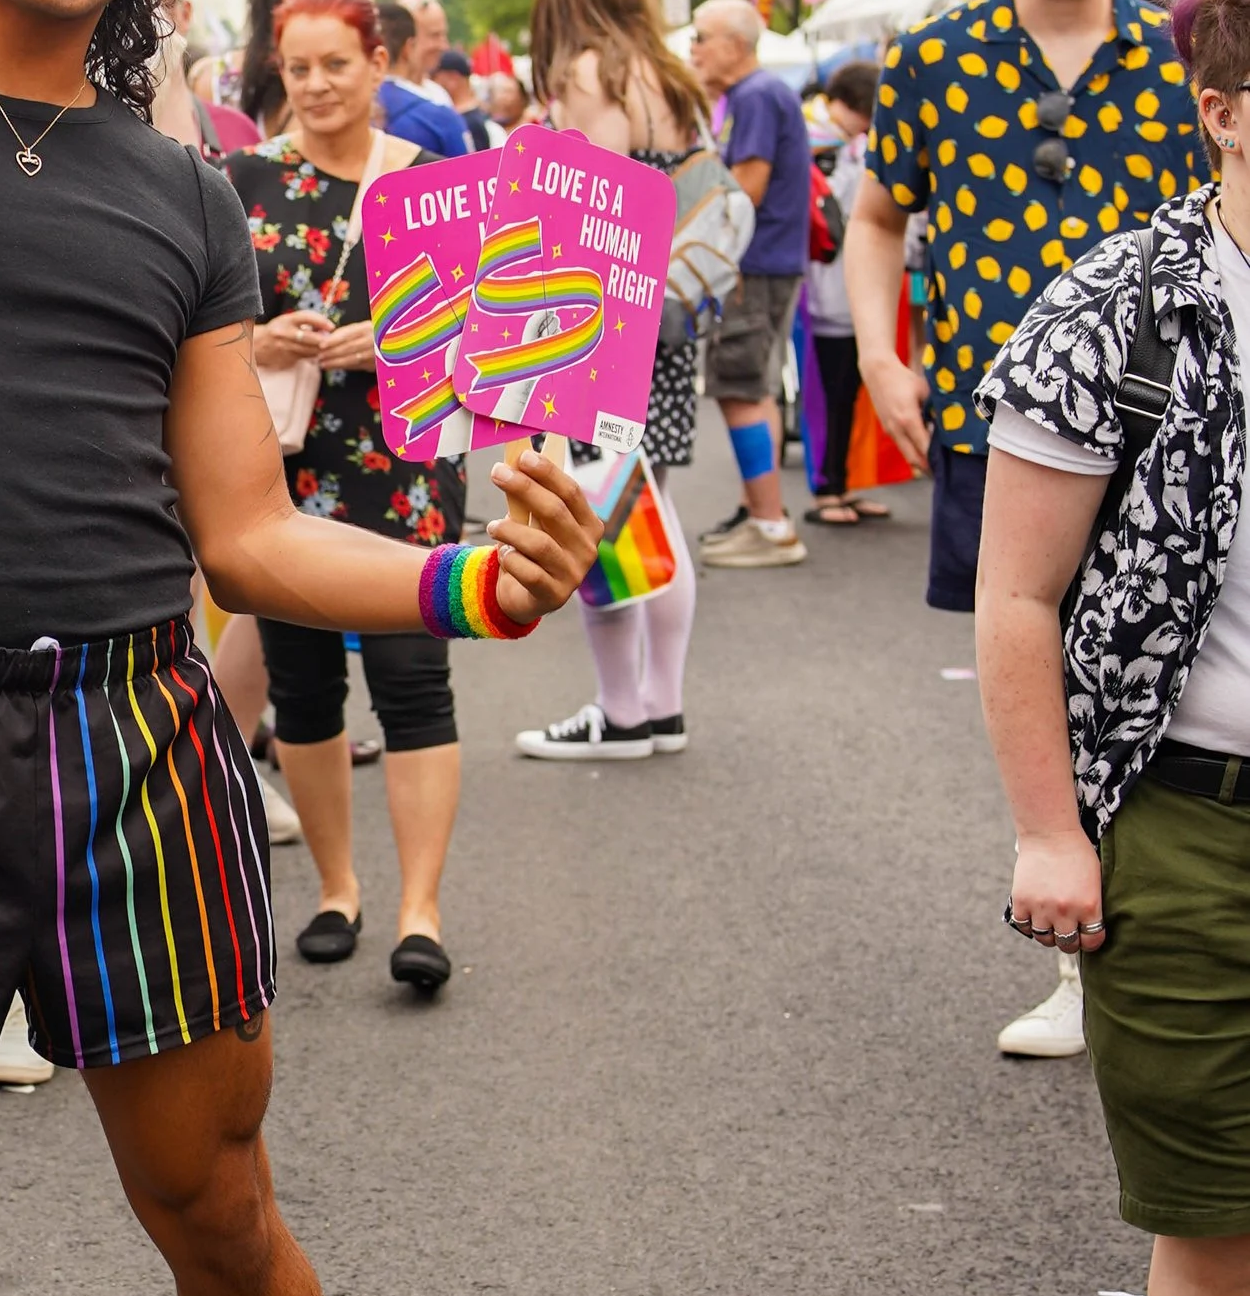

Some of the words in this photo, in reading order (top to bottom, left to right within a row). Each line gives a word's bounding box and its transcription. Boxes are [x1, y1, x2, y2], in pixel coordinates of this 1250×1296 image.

[403, 184, 471, 231] LOVE
[531, 157, 586, 204] LOVE
[589, 175, 610, 212] IS
[611, 184, 624, 218] A
[579, 213, 642, 265] HUMAN
[606, 263, 658, 310] RIGHT
[600, 420, 624, 434] AMNESTY
